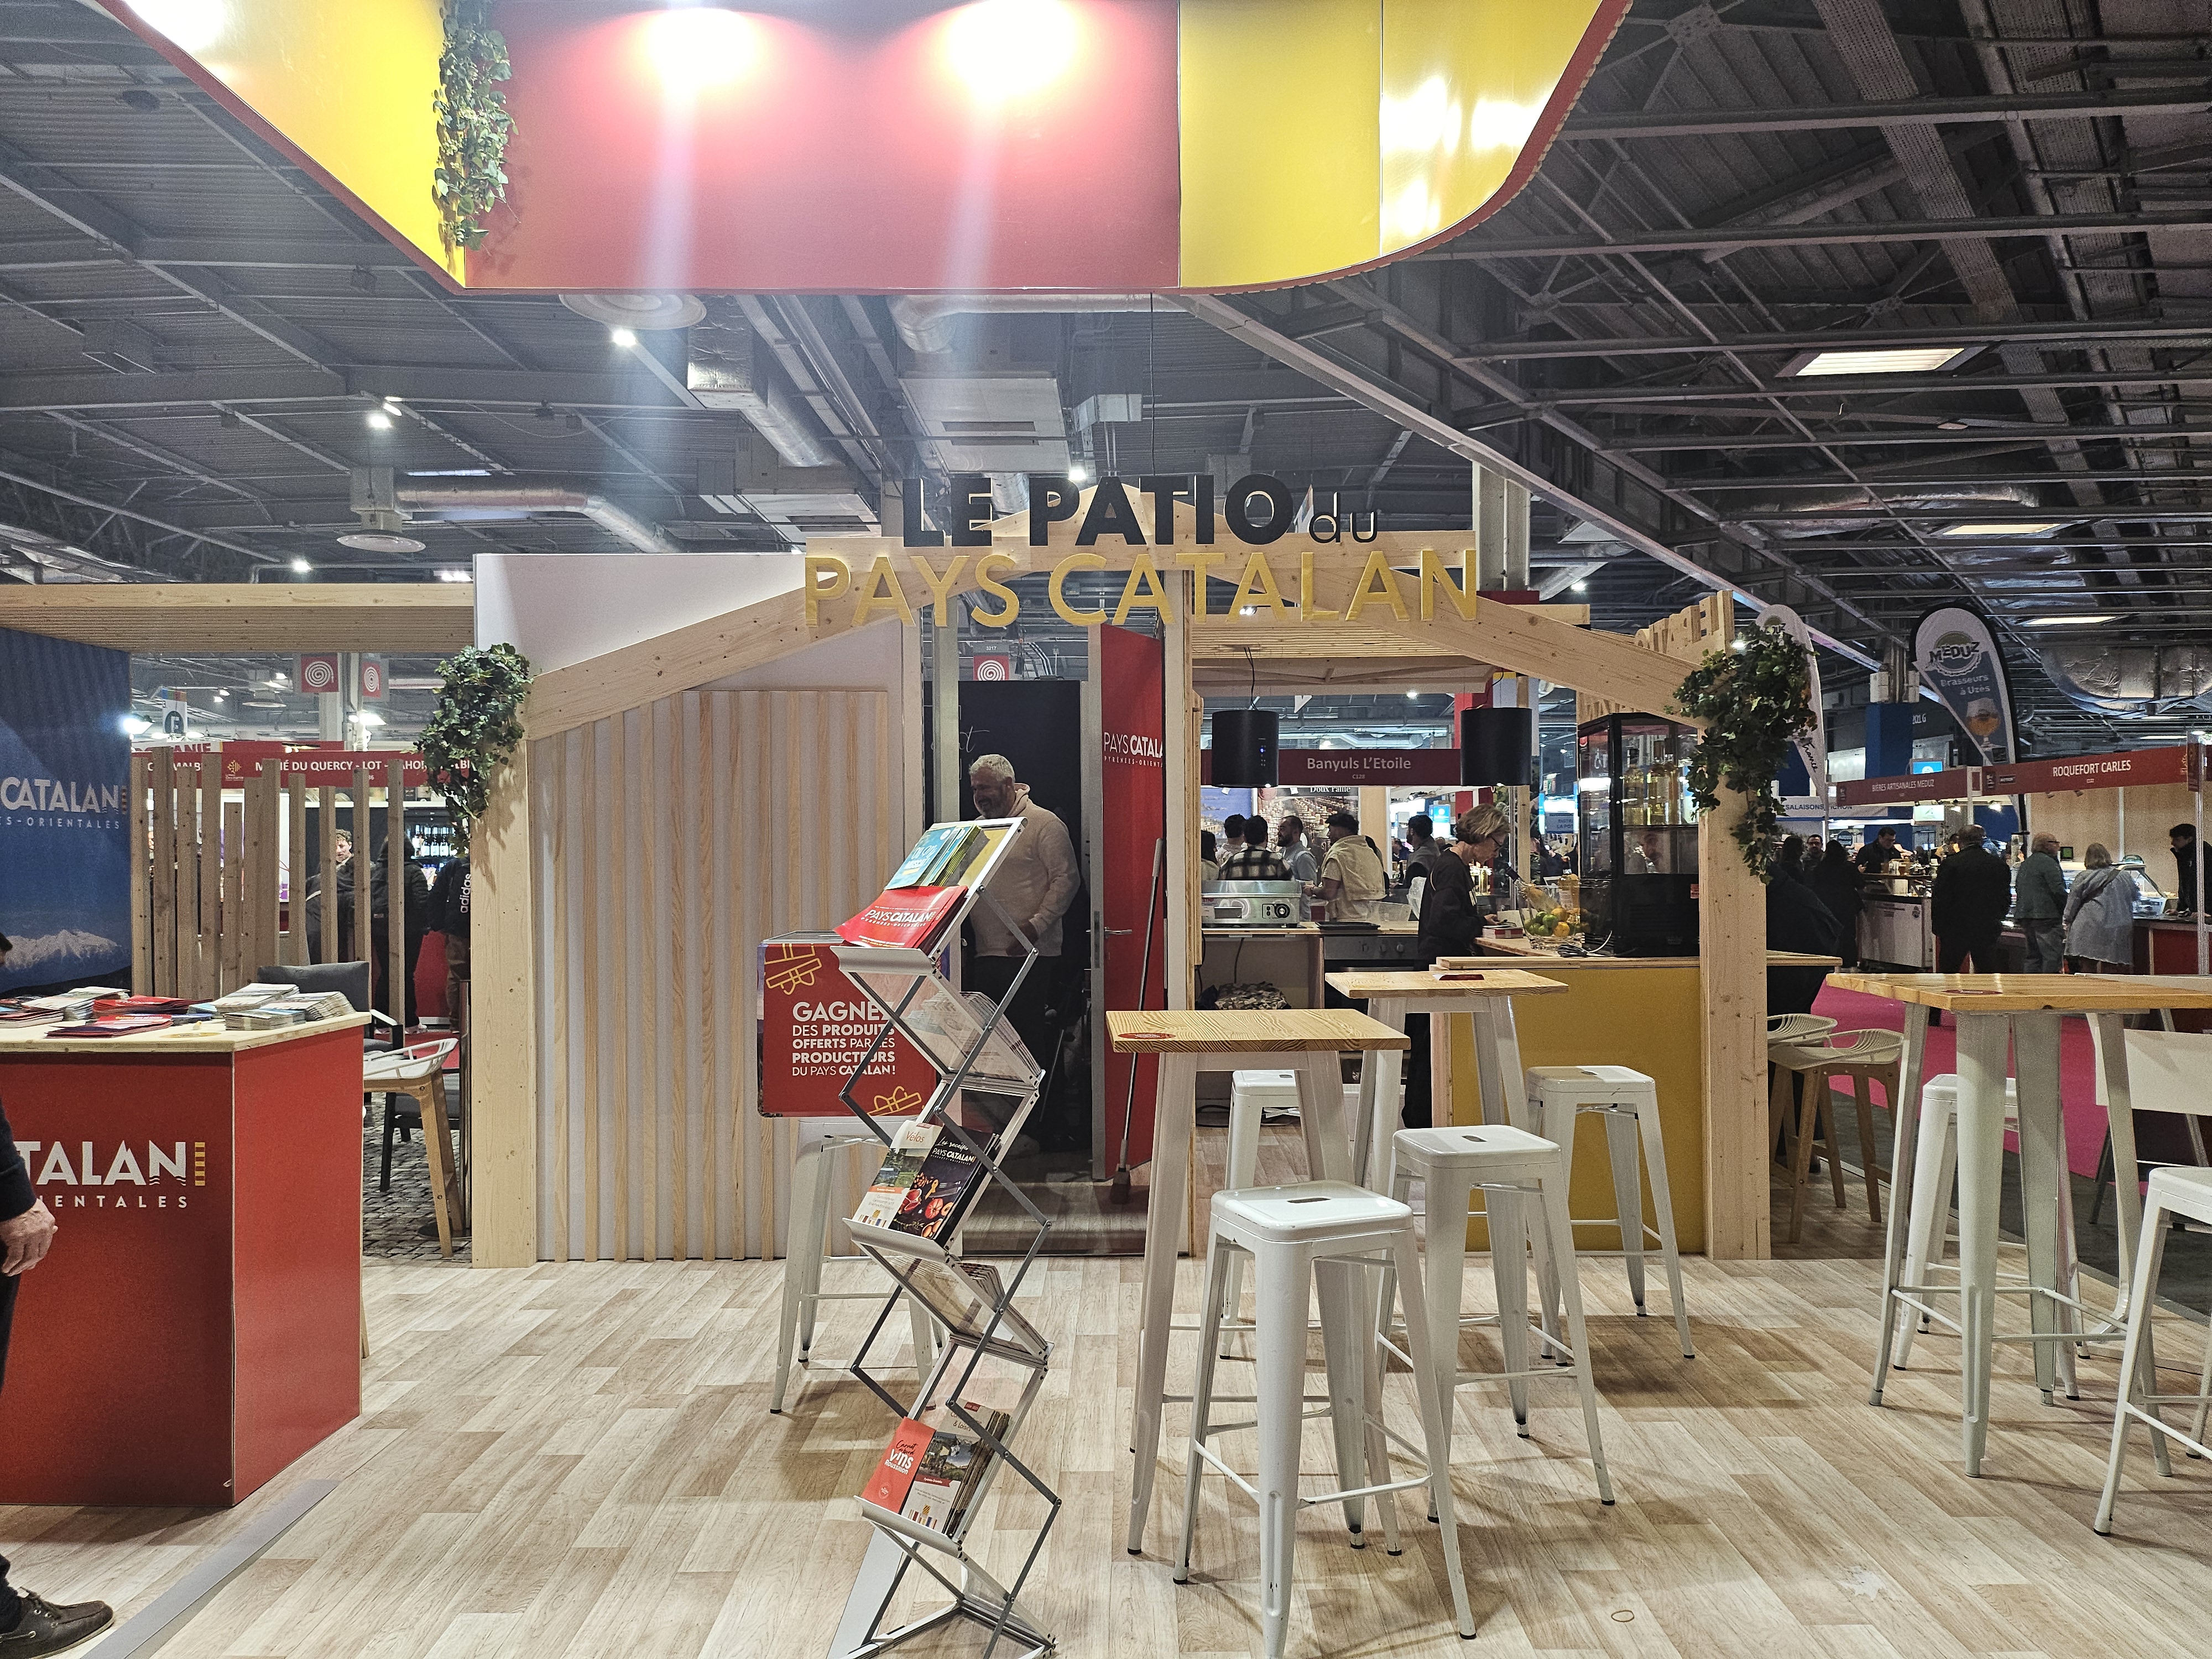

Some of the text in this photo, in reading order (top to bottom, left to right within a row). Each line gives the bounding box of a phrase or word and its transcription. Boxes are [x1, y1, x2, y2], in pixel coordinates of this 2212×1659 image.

[902, 474, 1378, 548] LE PATIO du
[805, 550, 1477, 628] PAYS CATALAN
[1929, 641, 1980, 663] MEDUZ
[1940, 675, 1989, 687] Brasseurs
[1104, 732, 1129, 754] PAYS
[292, 762, 307, 770] DU
[310, 761, 353, 771] QUERCY
[363, 760, 382, 769] LOT
[1307, 757, 1411, 771] Banyuls L'Etoile
[2053, 760, 2131, 777] ROQUEFORT CARLES
[1887, 781, 1916, 791] ARTISANALES
[1917, 779, 1934, 788] MEDUZ
[1, 777, 119, 814] CATALAN
[0, 816, 119, 829] S-ORIENTALES
[460, 874, 471, 913] adidas
[865, 910, 891, 921] PAYS
[890, 912, 931, 922] CATALAN
[792, 1025, 818, 1036] DES
[792, 1037, 895, 1049] OFFERTS PAR ES
[792, 1067, 807, 1076] DU
[810, 1066, 837, 1076] PAYS
[906, 1131, 925, 1142] Vélos
[932, 1147, 974, 1162] PAYS CATALAN
